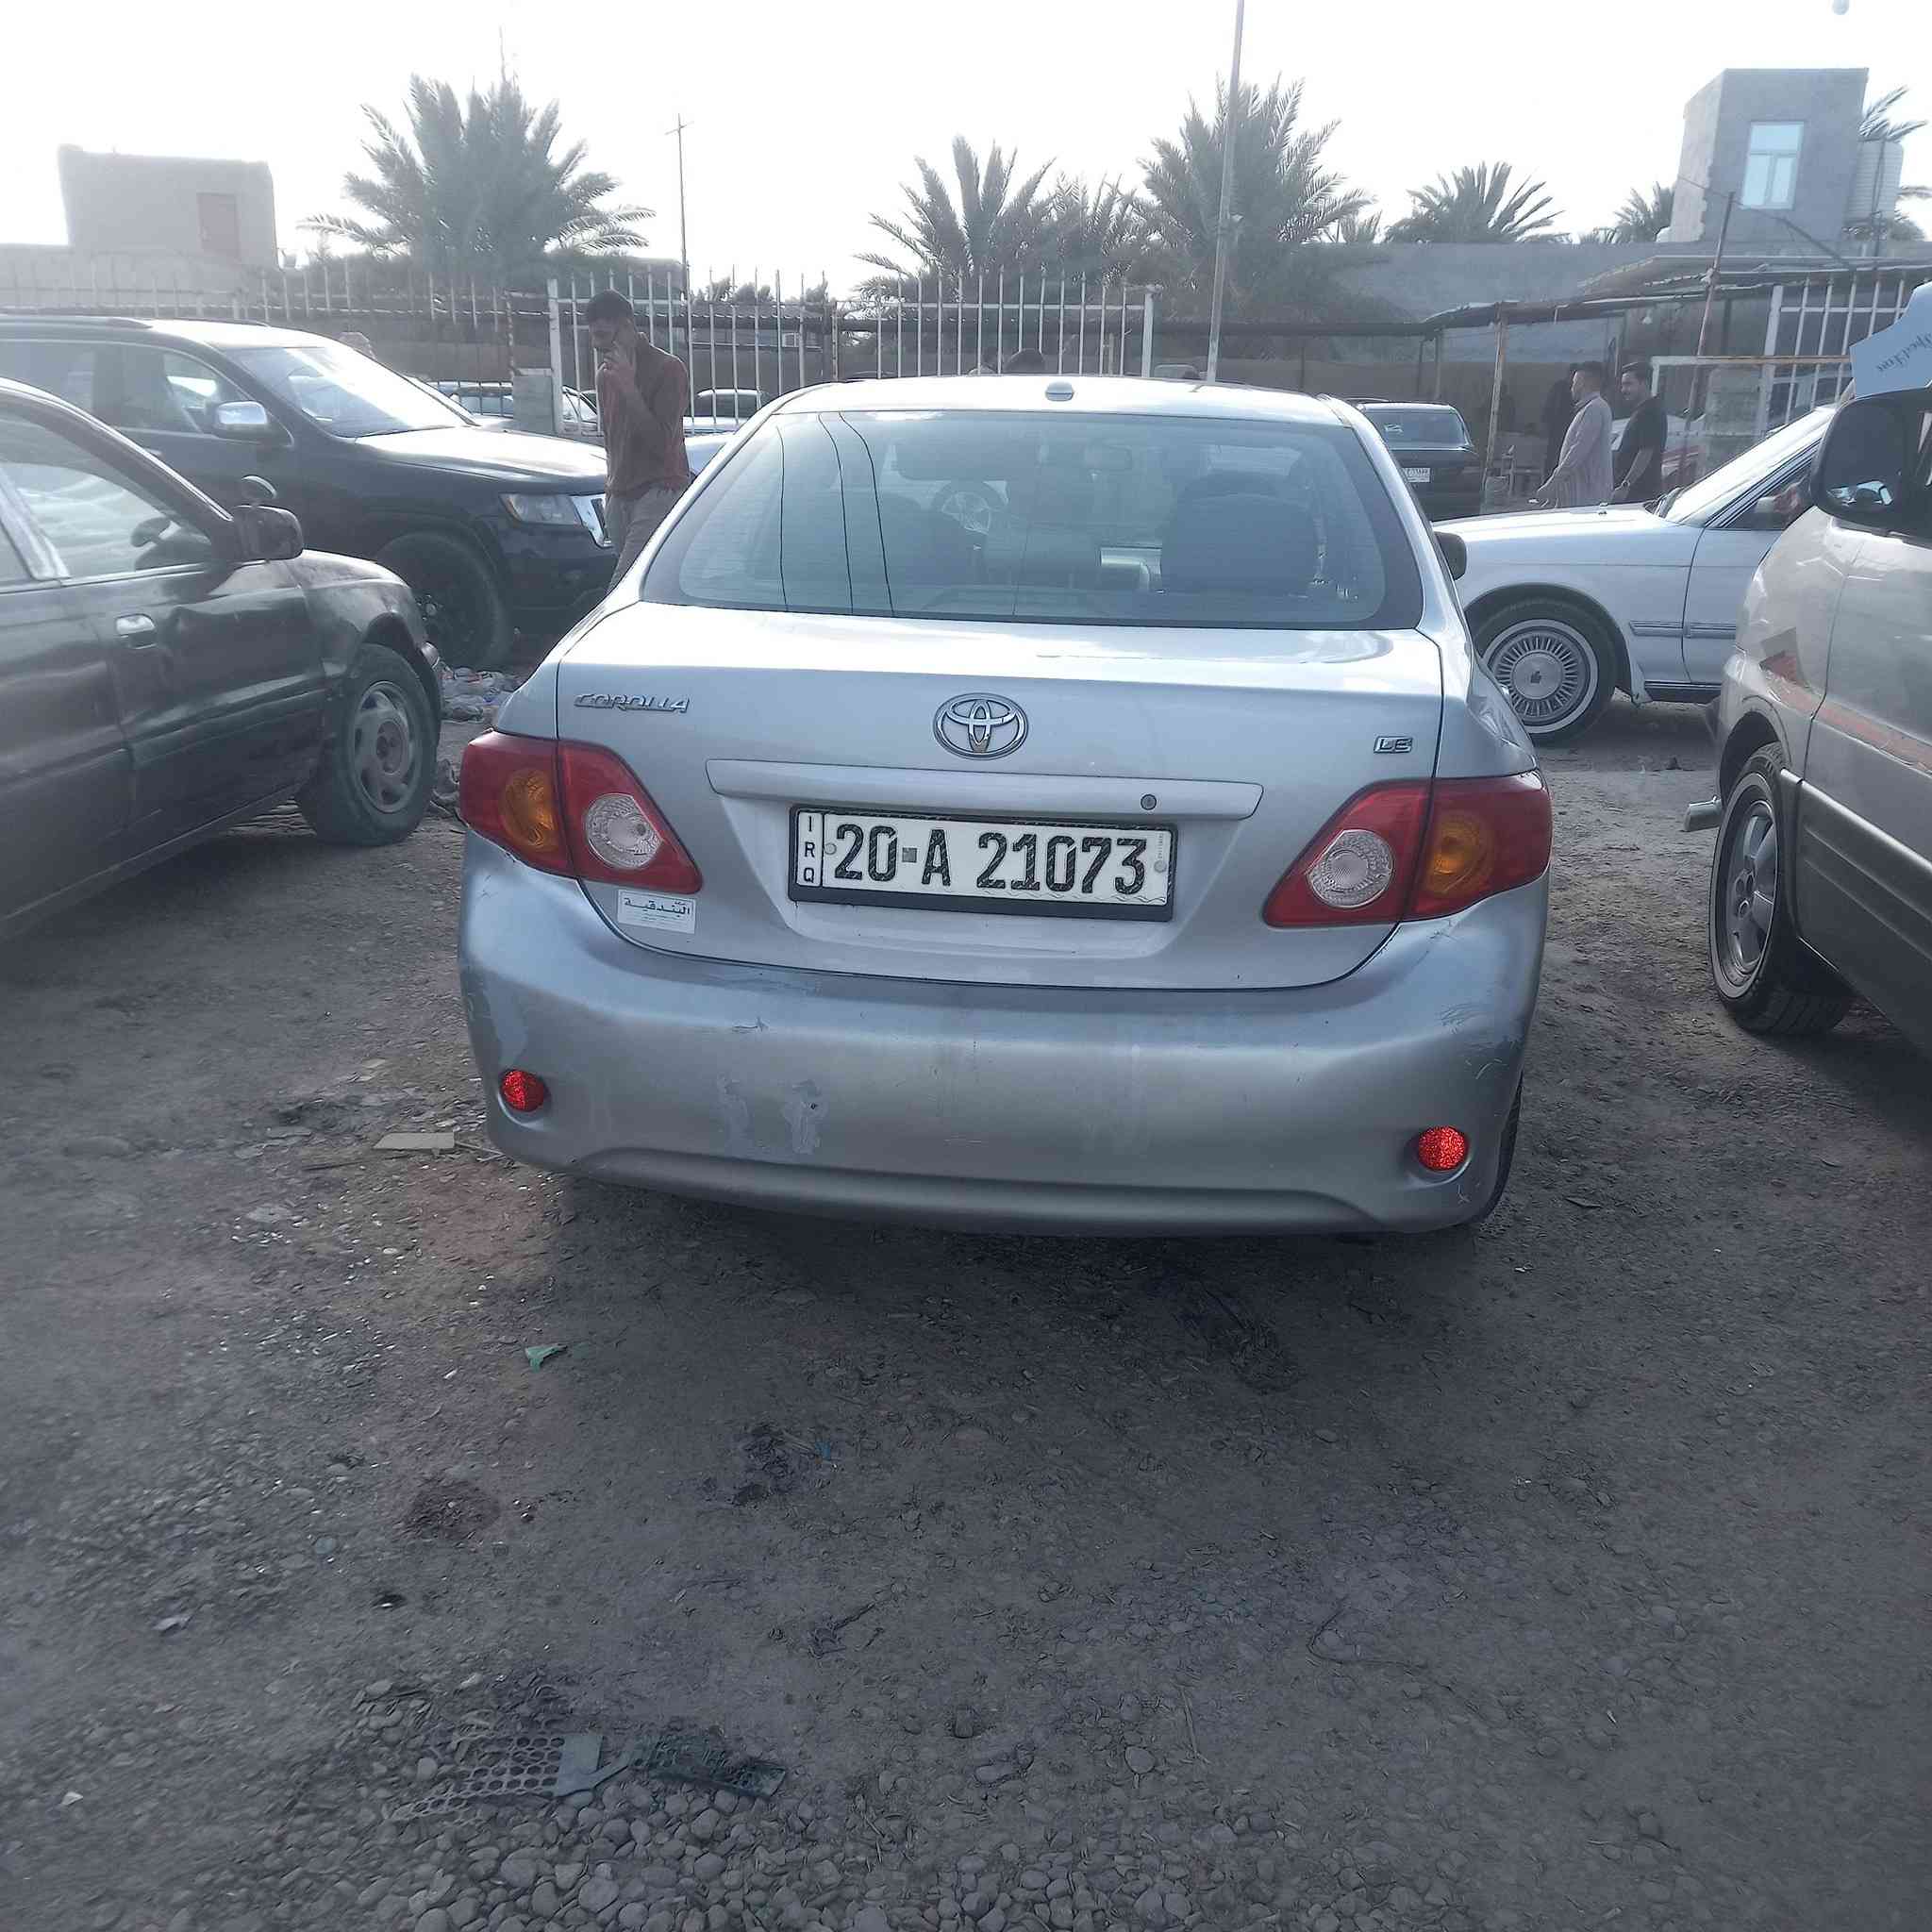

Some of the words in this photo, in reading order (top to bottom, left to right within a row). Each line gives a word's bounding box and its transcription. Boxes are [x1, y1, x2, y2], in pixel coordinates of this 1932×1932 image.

[574, 693, 691, 713] COROLLA
[1374, 736, 1413, 754] LE
[803, 816, 815, 883] IRQ
[976, 832, 1147, 895] 21073
